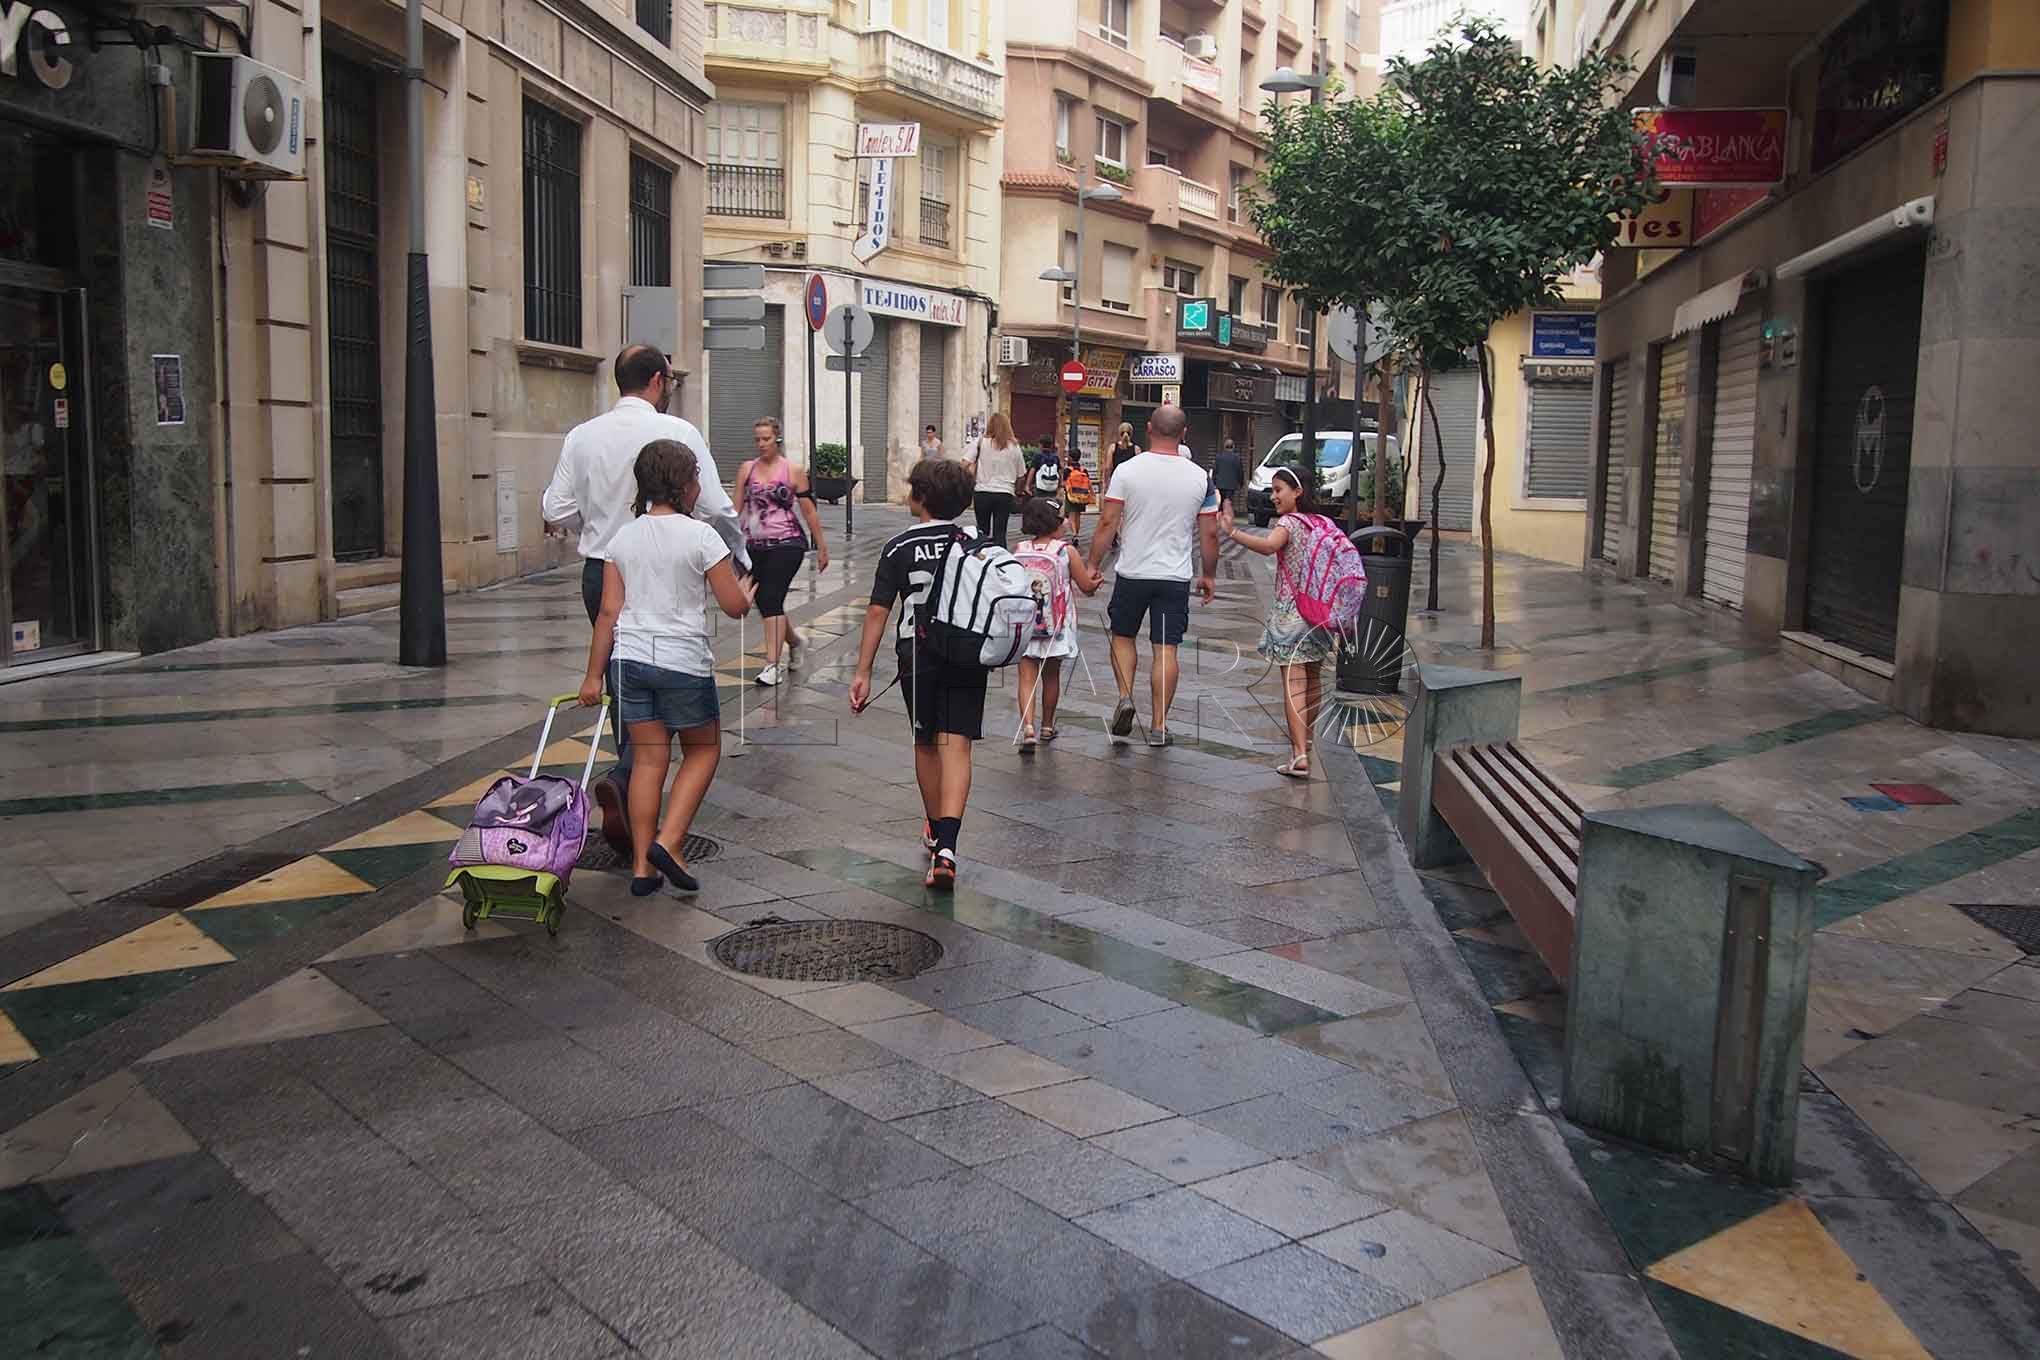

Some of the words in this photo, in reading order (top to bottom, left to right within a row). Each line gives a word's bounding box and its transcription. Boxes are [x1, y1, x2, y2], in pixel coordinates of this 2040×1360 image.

[871, 159, 888, 249] TEJIDOS
[864, 287, 927, 313] TEJIDOS
[1132, 365, 1177, 377] CARRASCO
[1536, 366, 1552, 377] LA
[914, 542, 948, 562] ALE
